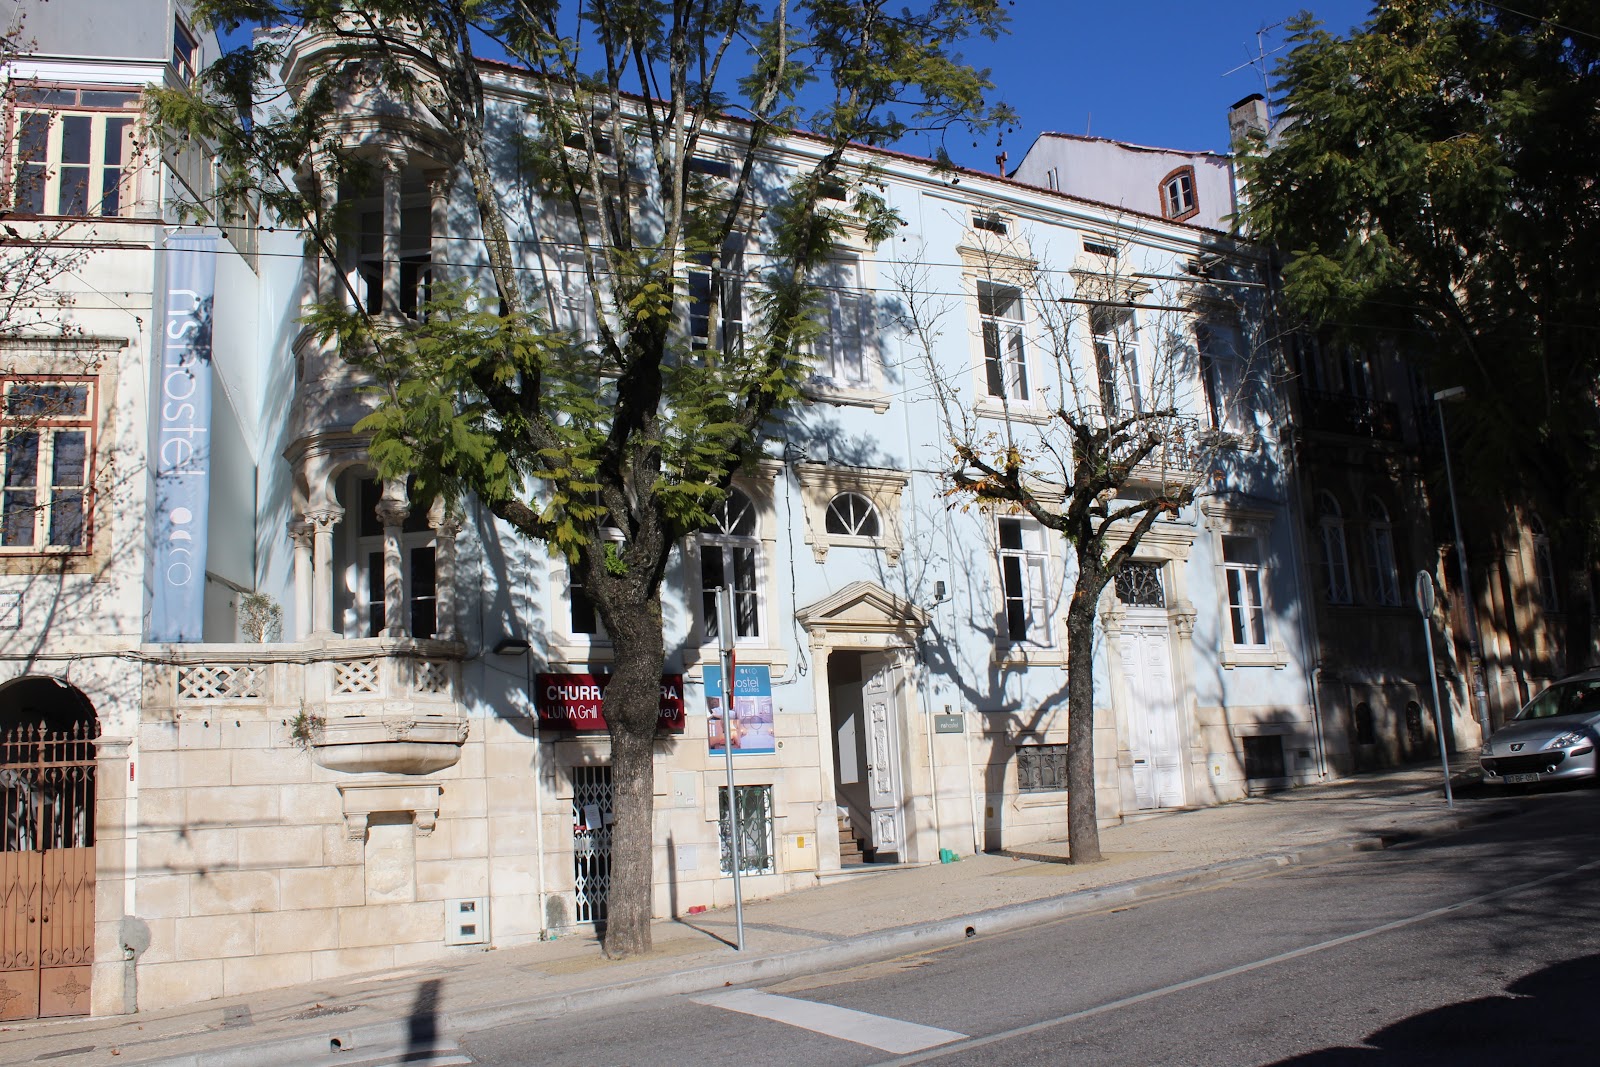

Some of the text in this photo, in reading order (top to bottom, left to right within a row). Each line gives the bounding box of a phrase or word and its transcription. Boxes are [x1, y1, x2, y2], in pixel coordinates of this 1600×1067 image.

[717, 677, 759, 688] nostel
[547, 705, 577, 719] LUNA
[578, 704, 598, 719] Grill
